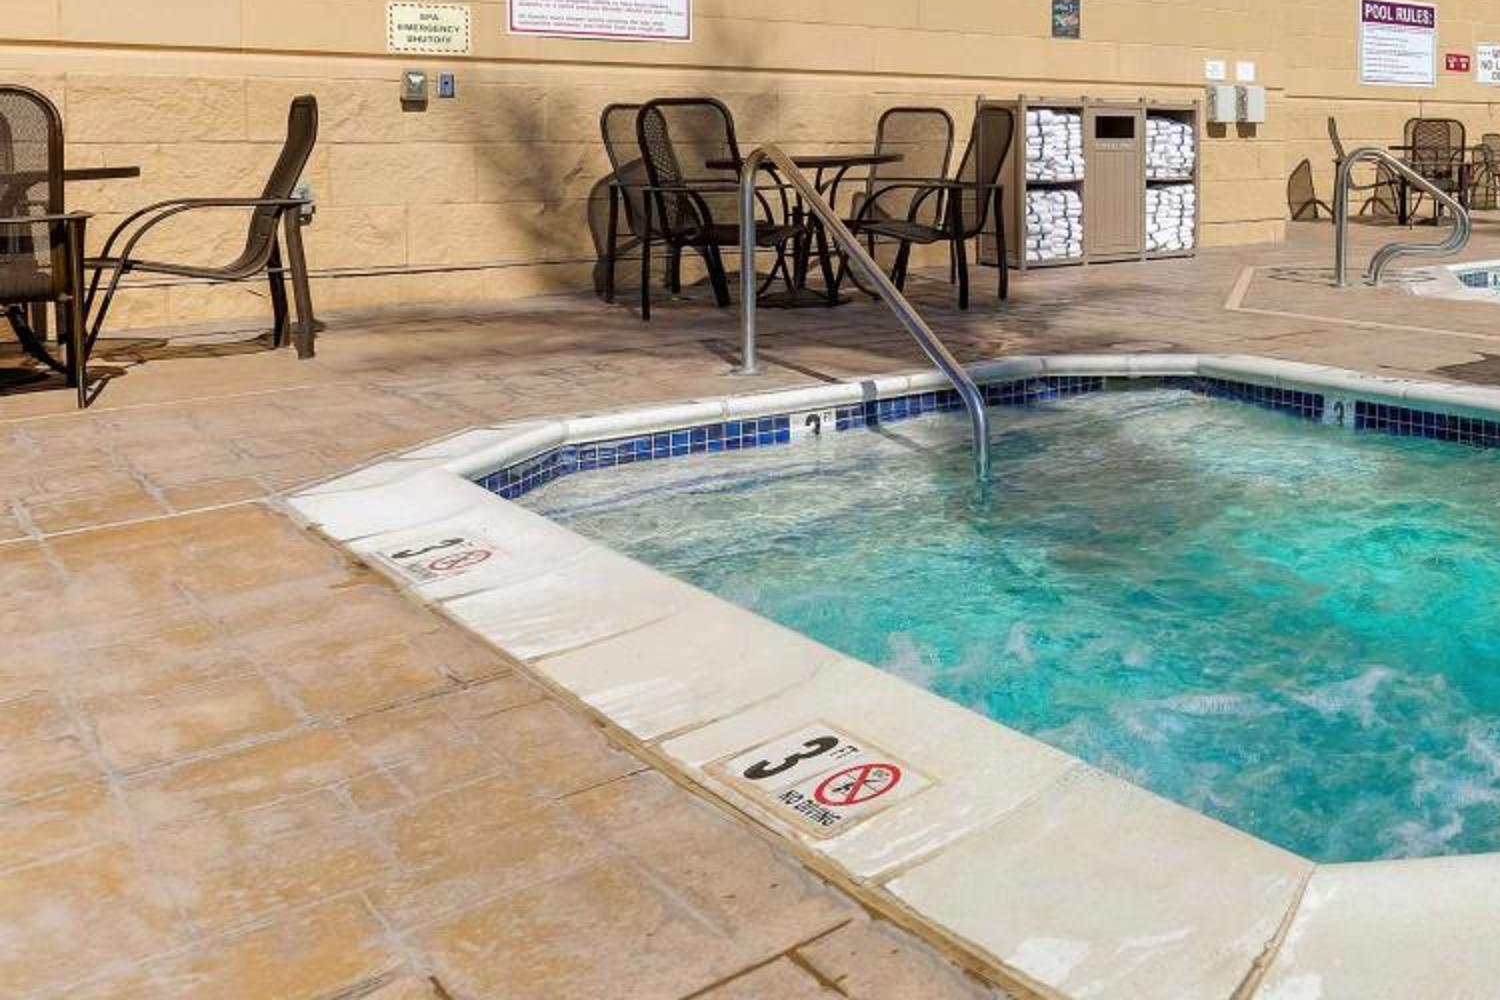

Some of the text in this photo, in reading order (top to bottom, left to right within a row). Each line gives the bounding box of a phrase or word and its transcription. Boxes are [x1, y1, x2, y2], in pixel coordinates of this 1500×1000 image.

[420, 12, 440, 21] SPA
[1364, 4, 1393, 20] POOL
[397, 23, 461, 33] EMERGENCY
[1480, 60, 1493, 70] NO
[744, 736, 839, 780] 3
